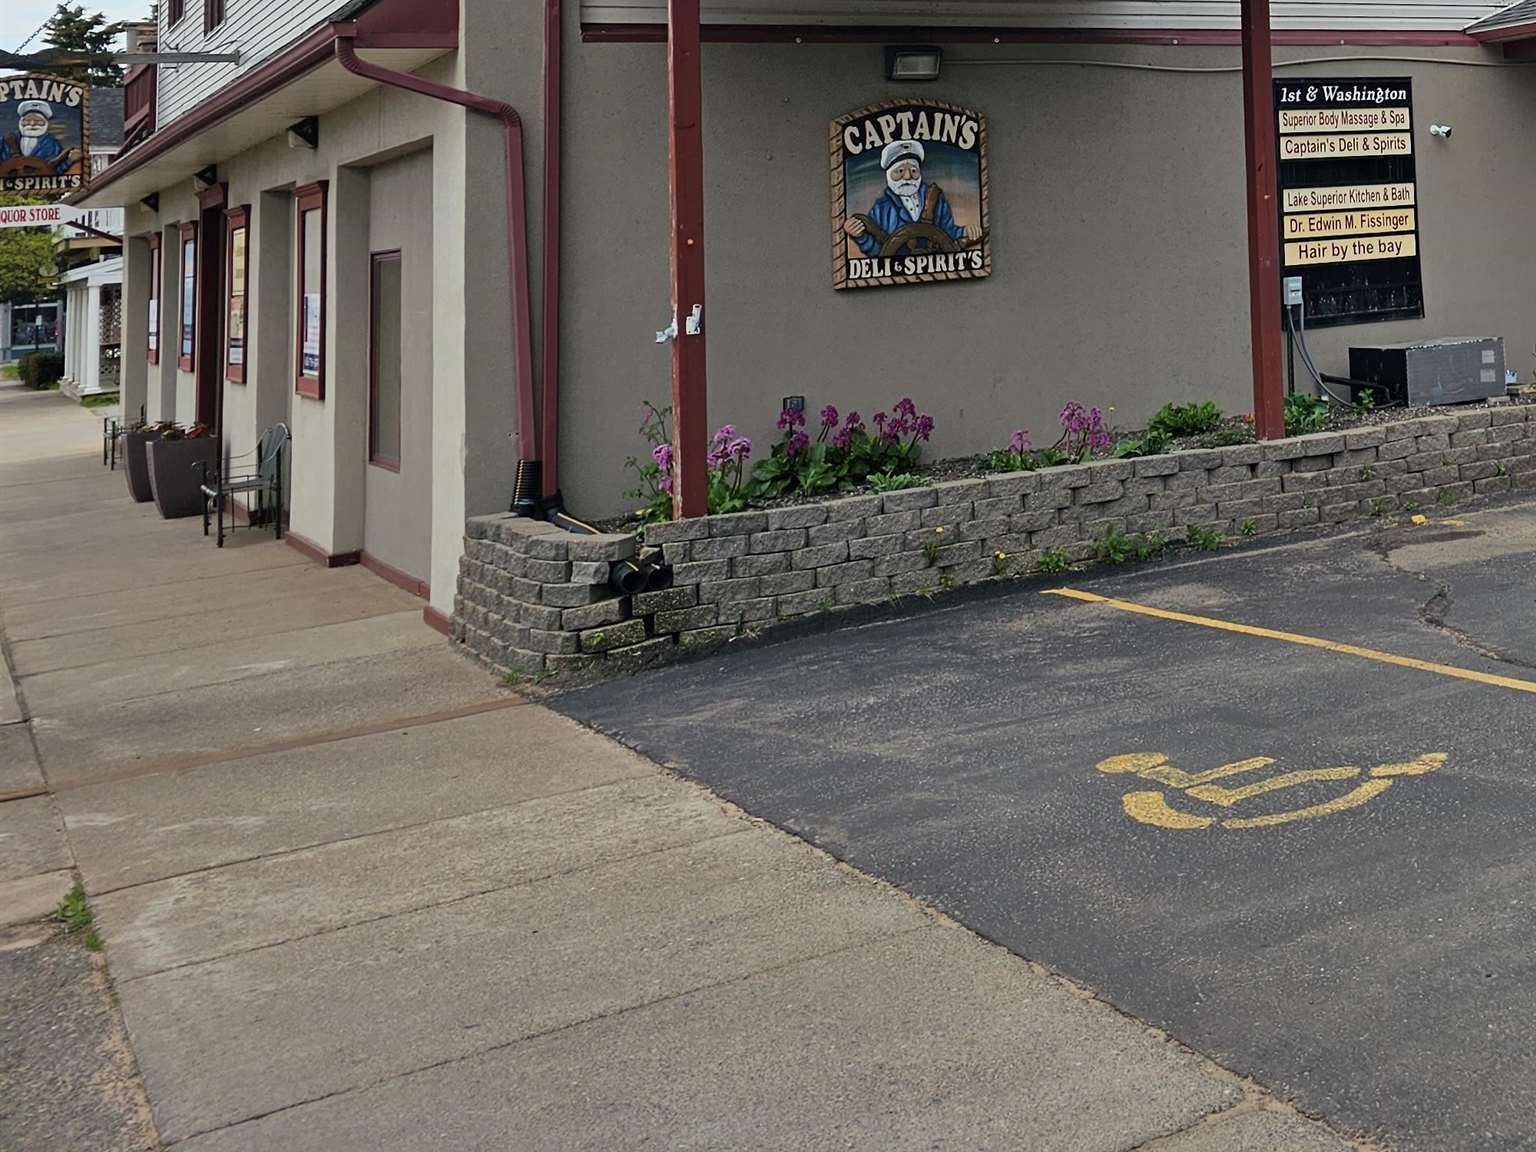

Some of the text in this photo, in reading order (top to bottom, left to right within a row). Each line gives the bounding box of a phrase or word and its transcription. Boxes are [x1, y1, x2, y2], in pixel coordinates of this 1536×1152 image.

[0, 79, 83, 107] PTAIN'S
[1280, 85, 1407, 104] 1st & Washington
[1282, 110, 1405, 128] Superior Body Massage & Spa
[843, 111, 979, 155] CAPTAIN'S
[1285, 136, 1406, 157] Captain's Deli & Spirits
[14, 175, 81, 191] SPIRIT'S
[1288, 187, 1410, 208] Lake Superior Kitchen & Bath
[0, 208, 61, 223] QUOR STORE
[1290, 213, 1408, 233] Dr. Edwin M. Fissinger
[1299, 240, 1402, 260] Hair by the bay
[849, 250, 983, 279] DELI & SPIRIT'S
